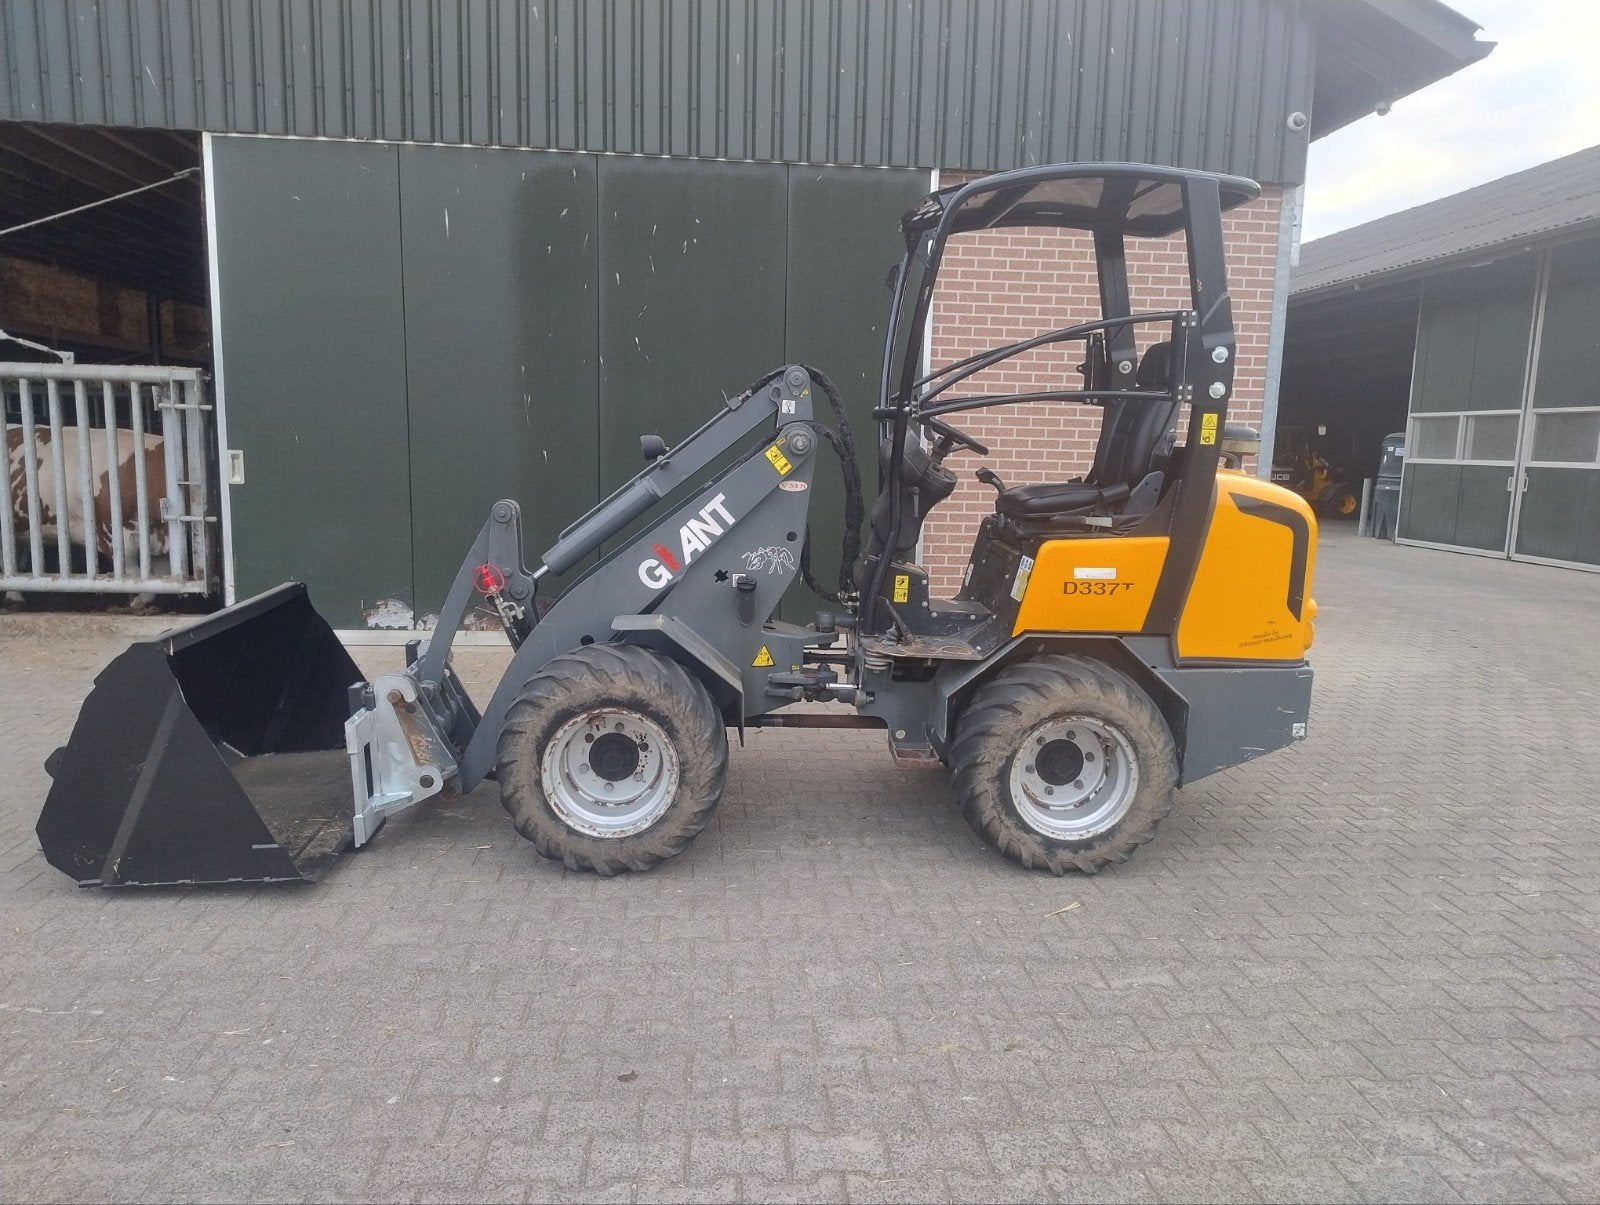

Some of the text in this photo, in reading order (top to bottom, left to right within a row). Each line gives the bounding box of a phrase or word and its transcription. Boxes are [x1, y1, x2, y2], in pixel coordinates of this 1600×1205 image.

[1271, 473, 1290, 481] JCB
[638, 492, 736, 590] GIANT
[1063, 581, 1136, 596] D337T
